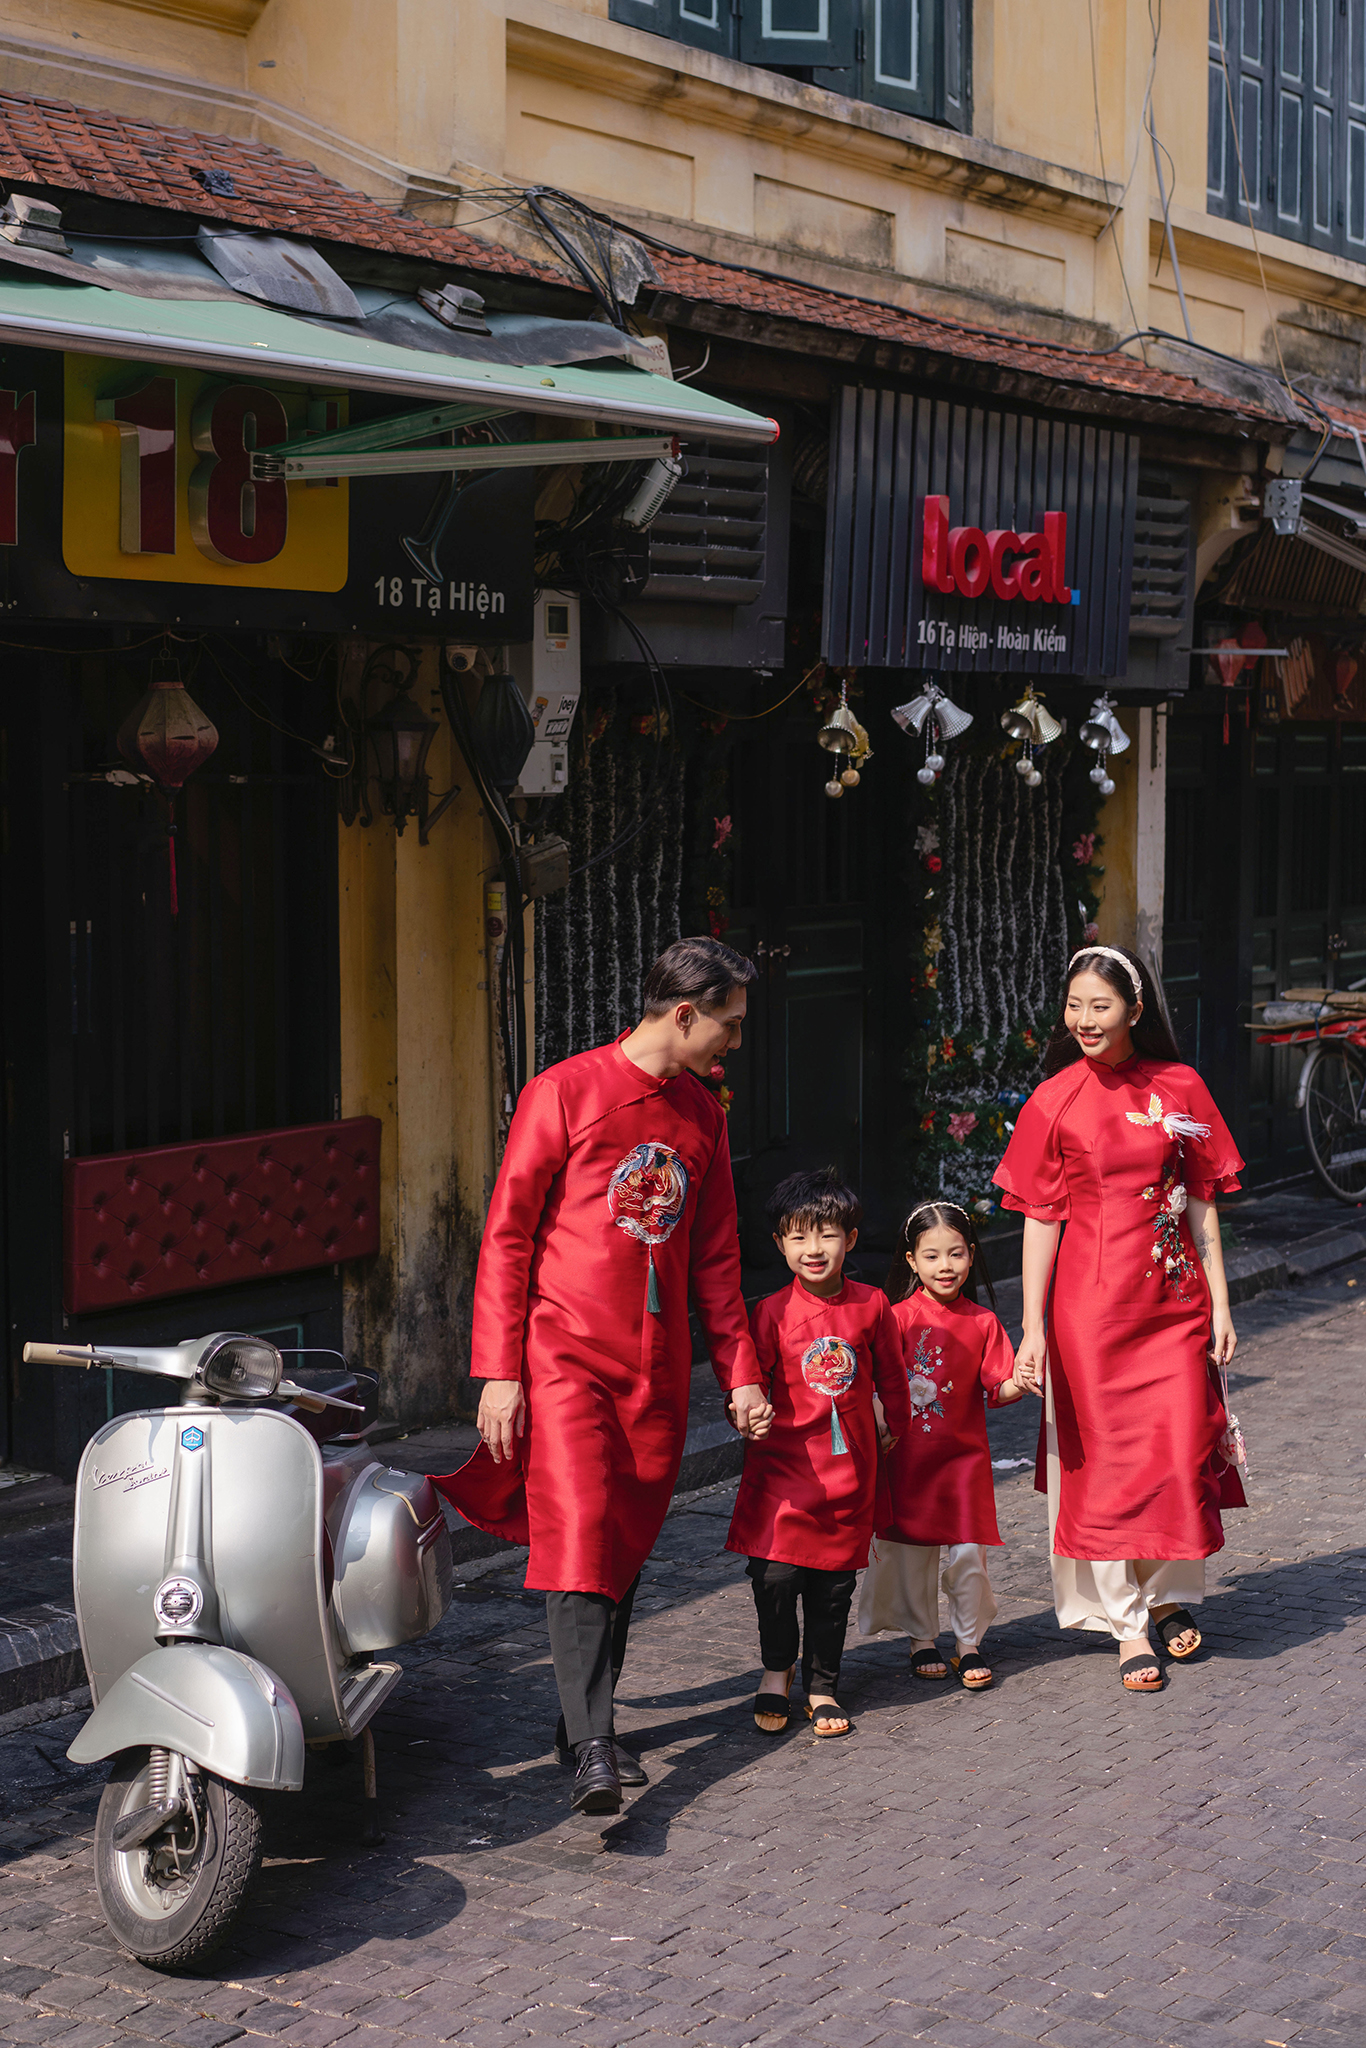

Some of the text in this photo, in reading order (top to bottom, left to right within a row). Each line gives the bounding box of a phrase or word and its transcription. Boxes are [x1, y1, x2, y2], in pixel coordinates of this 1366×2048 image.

[374, 576, 505, 620] 18 Tạ Hiện
[917, 620, 936, 645] 16
[938, 622, 955, 655] Tạ
[958, 624, 987, 655] Hiện
[997, 626, 1030, 651] Hoàn
[1033, 625, 1066, 652] Kiếm
[557, 696, 577, 715] joey
